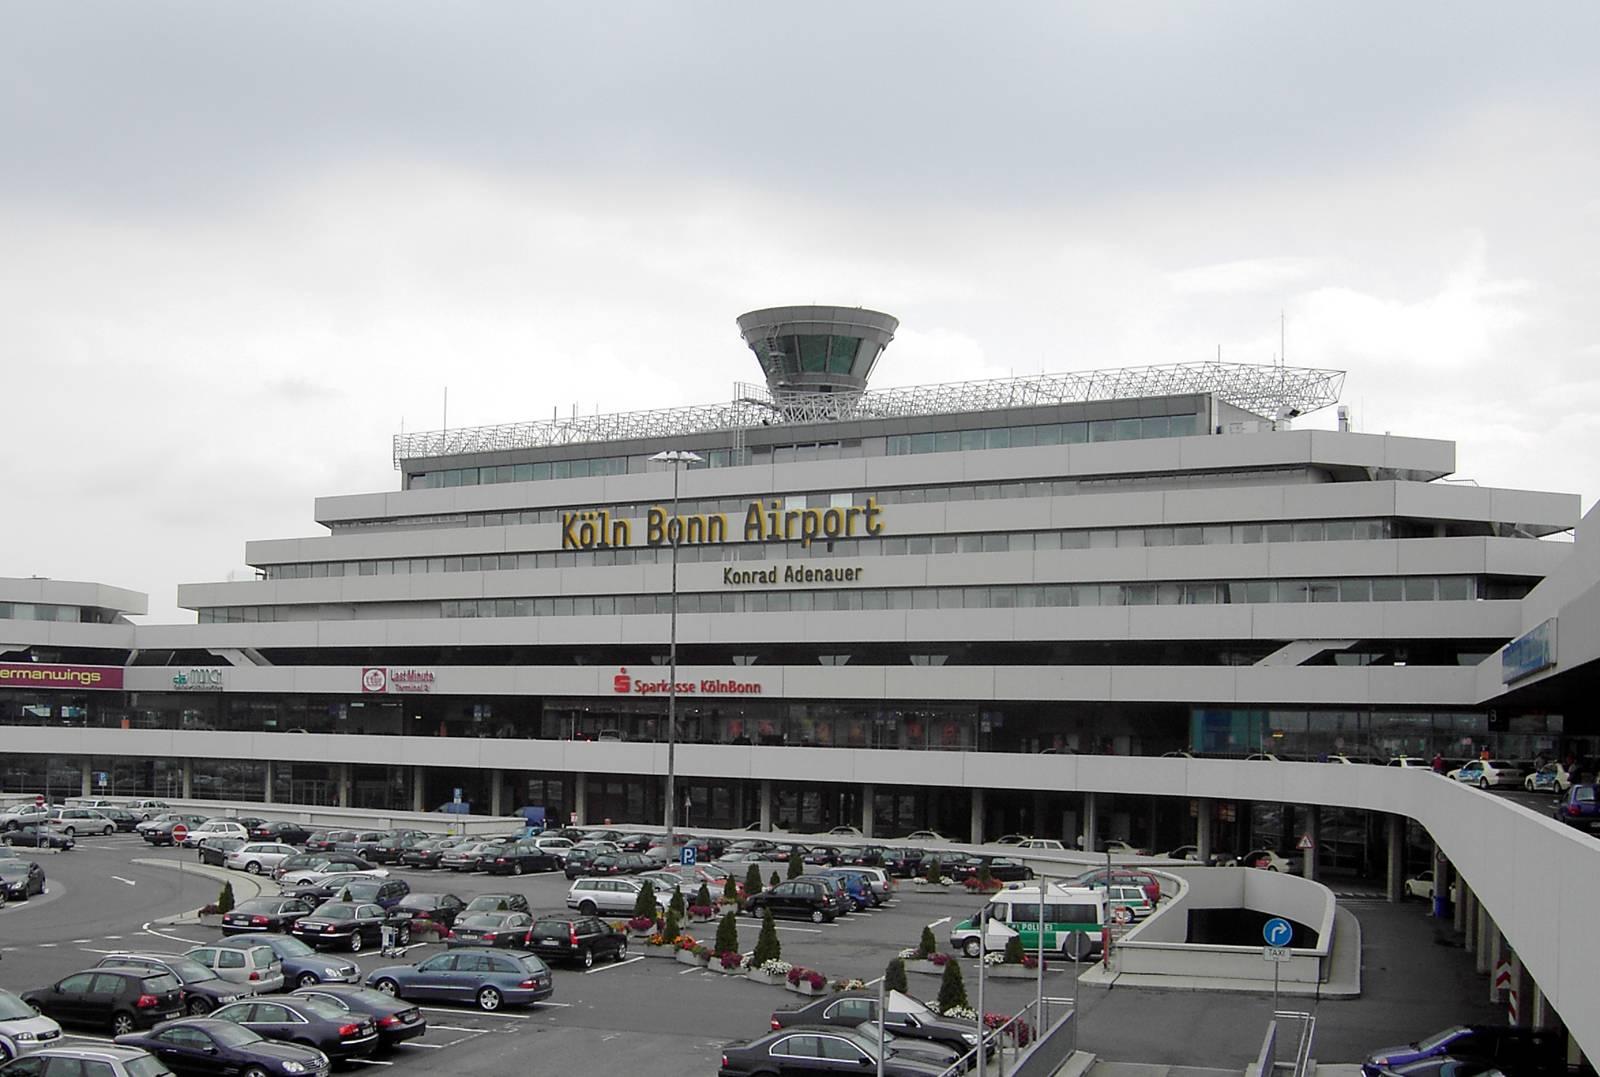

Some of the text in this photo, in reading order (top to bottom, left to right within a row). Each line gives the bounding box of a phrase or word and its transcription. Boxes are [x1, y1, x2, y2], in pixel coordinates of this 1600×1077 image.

[562, 496, 885, 549] Köln Bonn Airport
[723, 564, 863, 585] Konrad Adenauer
[634, 679, 761, 695] Sparksse KölnBonn
[684, 848, 693, 864] P
[1021, 922, 1053, 931] POLIEI
